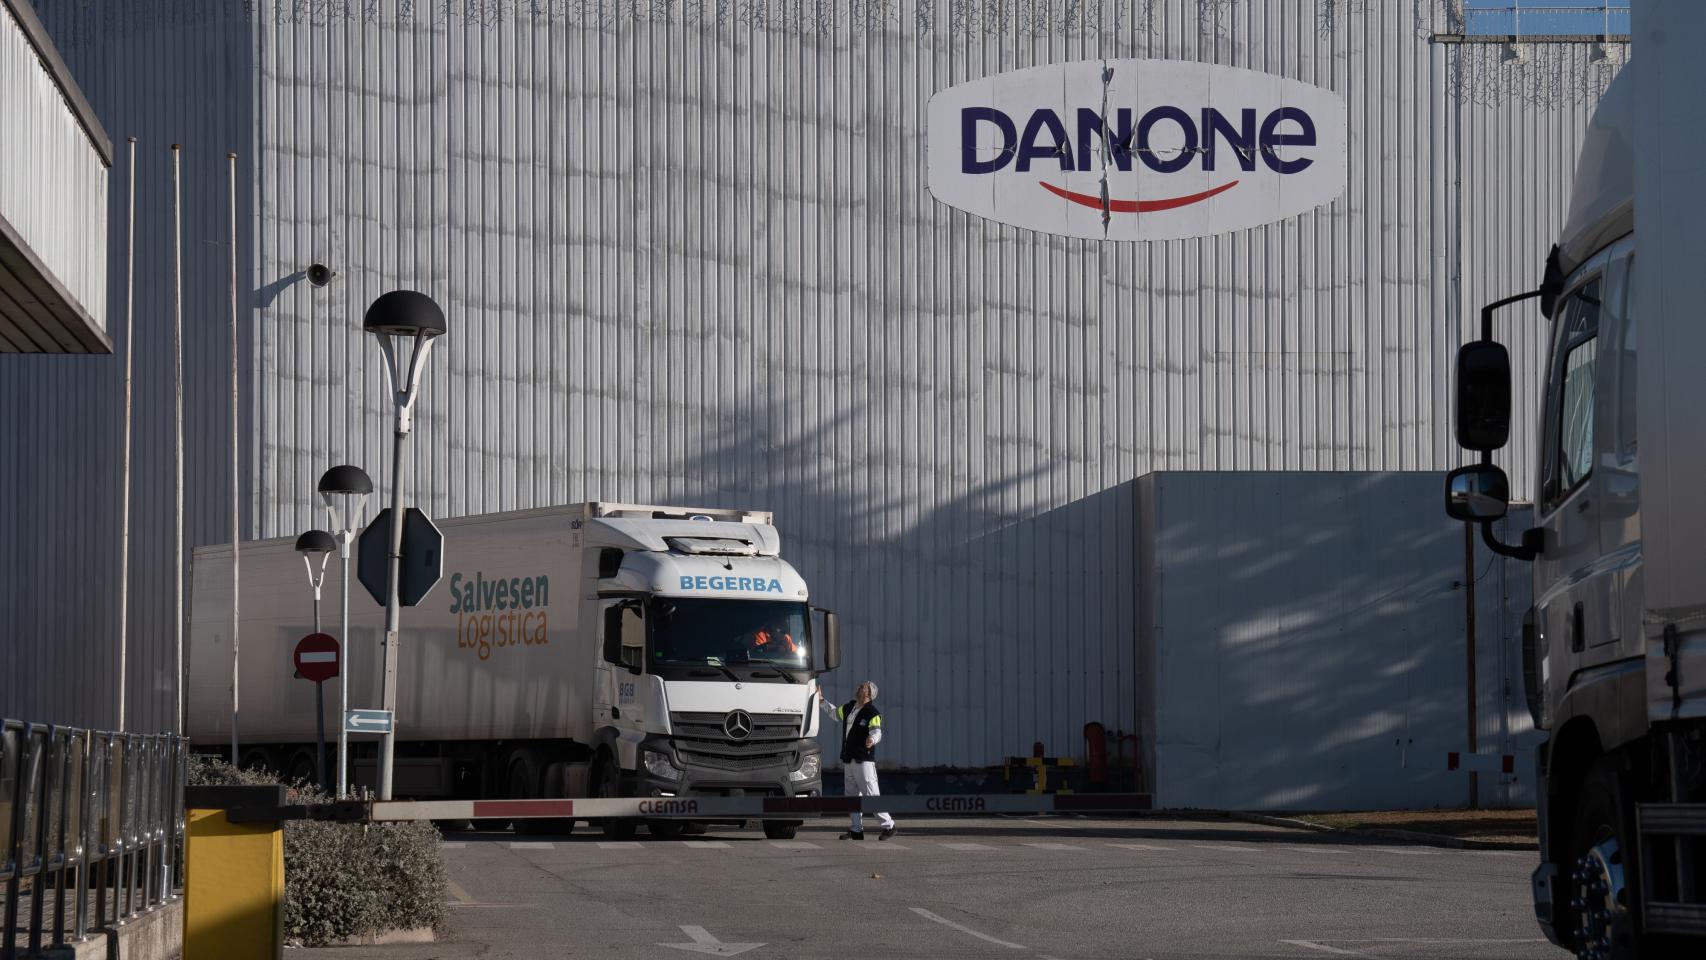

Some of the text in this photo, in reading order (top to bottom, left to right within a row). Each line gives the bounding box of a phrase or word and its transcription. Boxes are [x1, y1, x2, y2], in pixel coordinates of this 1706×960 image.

[450, 571, 549, 614] Salvesen
[680, 575, 783, 593] BEGERBA
[458, 605, 549, 660] Logística
[638, 800, 698, 814] CLEMSA
[927, 797, 985, 811] CLEMSA
